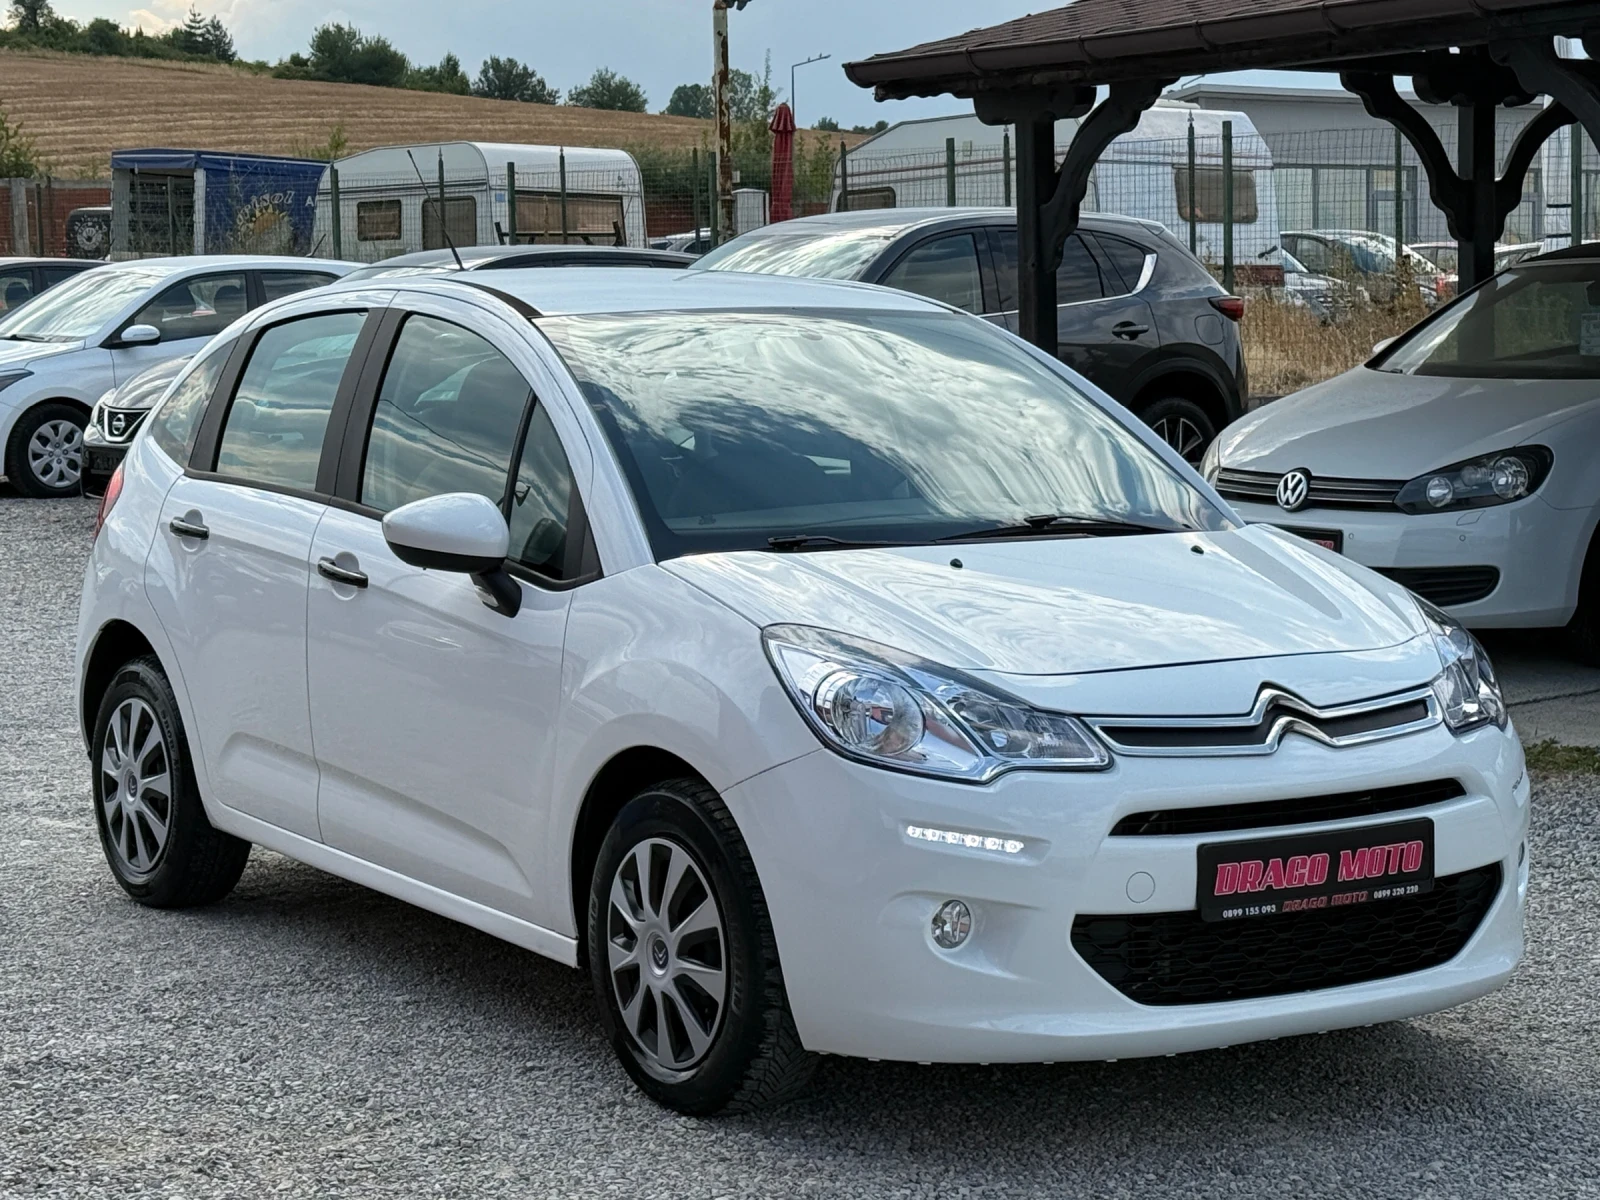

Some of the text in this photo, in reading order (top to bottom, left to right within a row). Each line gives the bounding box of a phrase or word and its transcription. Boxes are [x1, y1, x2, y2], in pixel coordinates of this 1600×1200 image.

[1214, 840, 1424, 896] DRAGO MOTO
[1222, 908, 1243, 918] 0899
[1245, 906, 1260, 916] 155
[1261, 904, 1277, 914] 093
[1282, 896, 1328, 912] DRAGO
[1331, 891, 1369, 906] MOTO
[1373, 889, 1391, 899] 0899
[1392, 887, 1405, 897] 320
